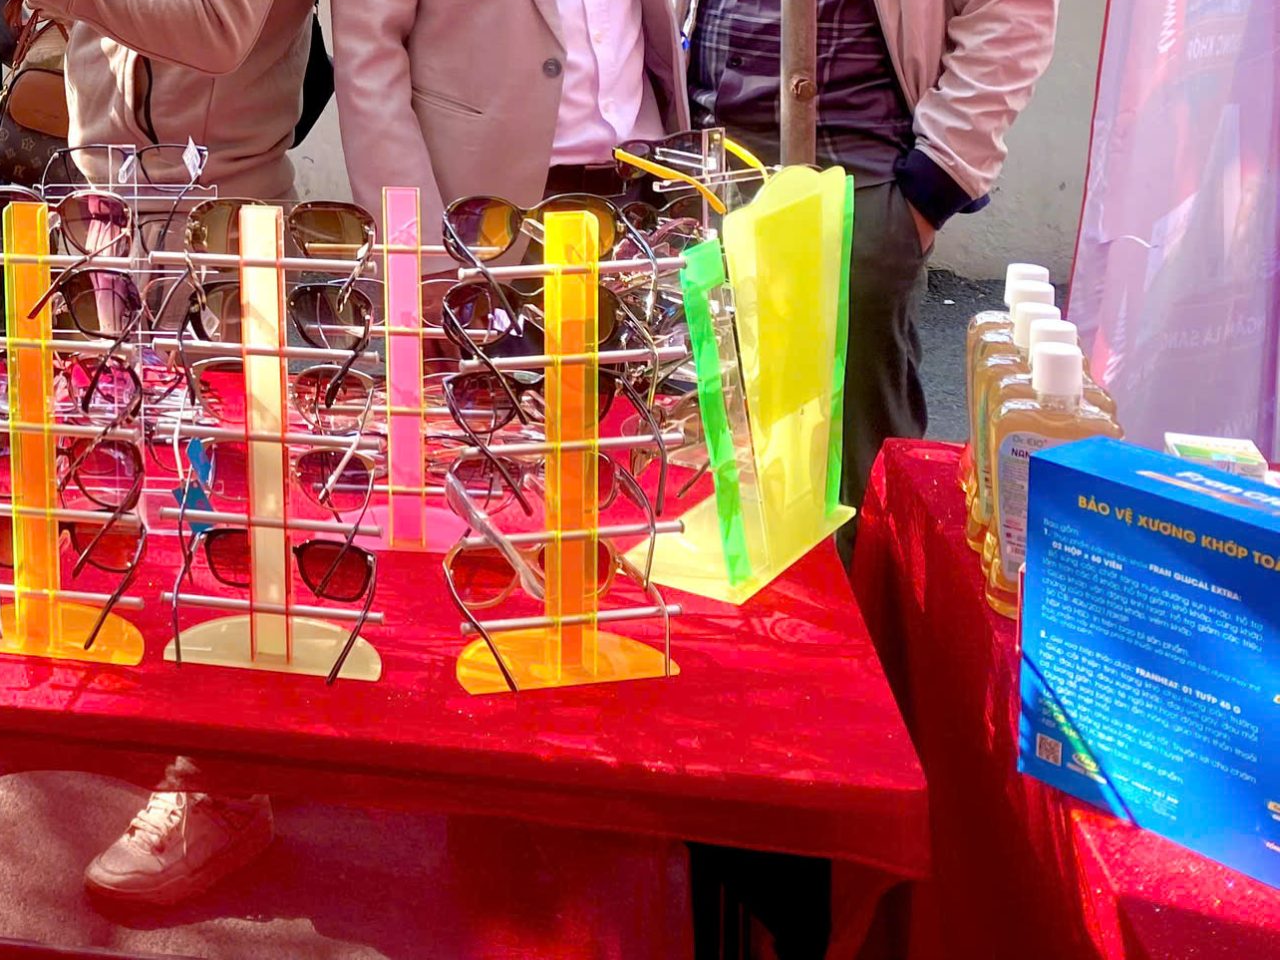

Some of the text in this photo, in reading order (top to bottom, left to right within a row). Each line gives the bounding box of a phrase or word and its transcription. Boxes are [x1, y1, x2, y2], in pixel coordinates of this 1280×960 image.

[1077, 494, 1111, 516] BẢO
[1115, 506, 1134, 527] VỆ
[1137, 513, 1197, 544] XƯƠNG
[1201, 533, 1249, 559] KHỚP
[1063, 543, 1082, 560] HỘP
[1149, 562, 1171, 578] FRAN
